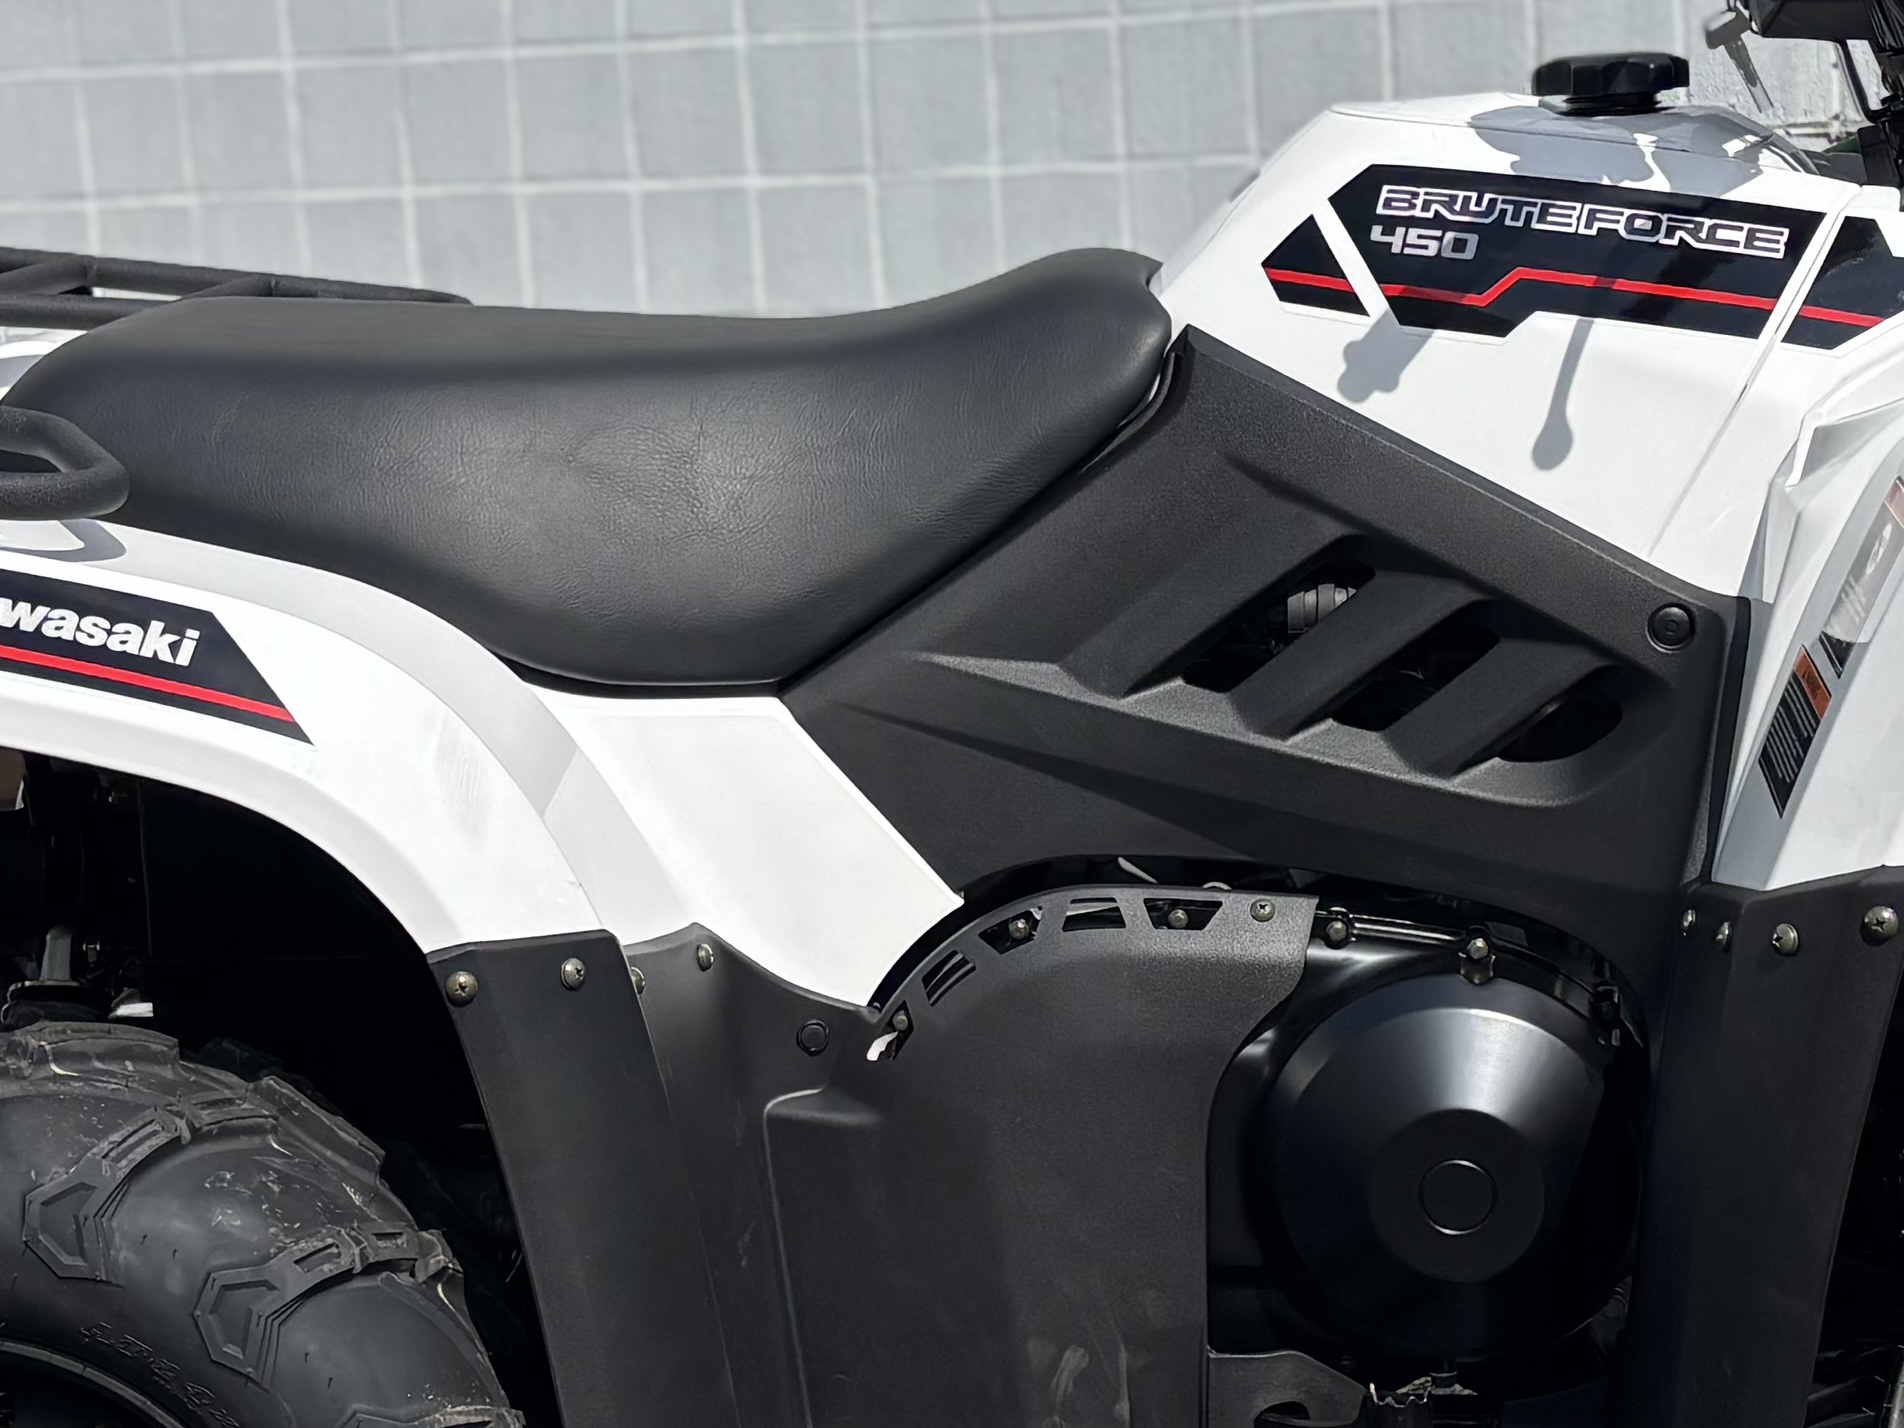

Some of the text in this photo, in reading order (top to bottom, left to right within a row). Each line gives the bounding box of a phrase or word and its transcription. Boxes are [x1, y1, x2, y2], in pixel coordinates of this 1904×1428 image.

[1369, 224, 1480, 260] 450
[1374, 184, 1790, 260] BRUTE FORCE
